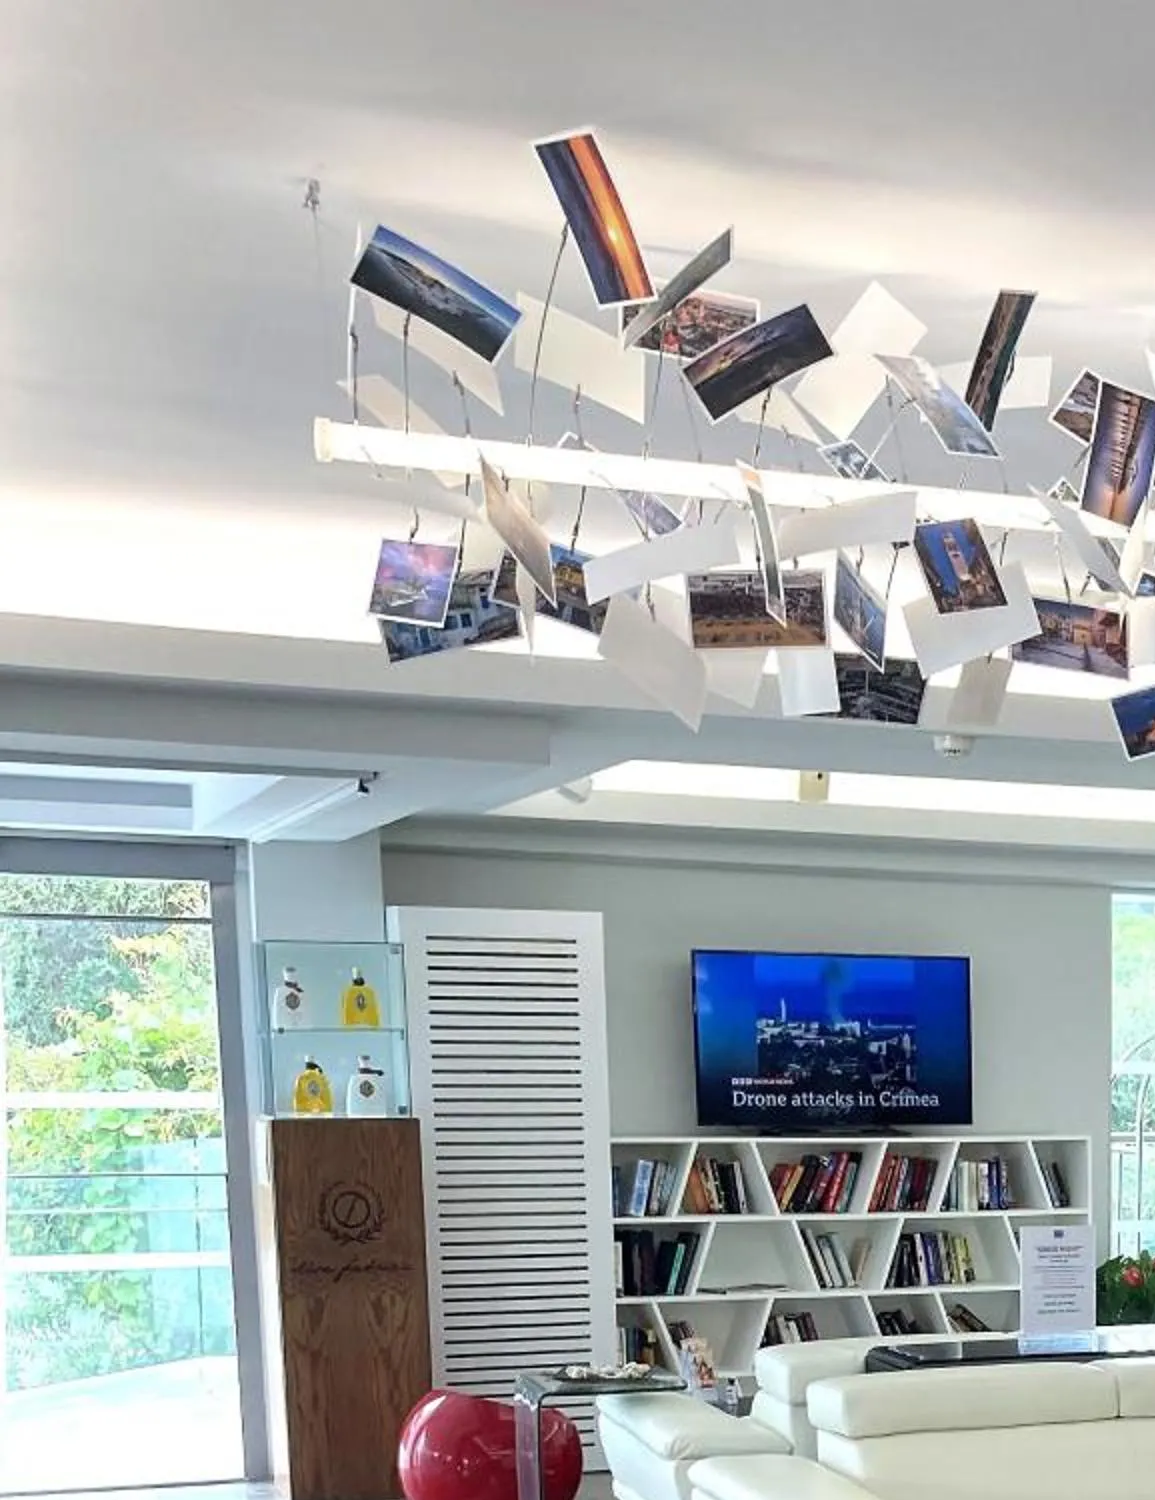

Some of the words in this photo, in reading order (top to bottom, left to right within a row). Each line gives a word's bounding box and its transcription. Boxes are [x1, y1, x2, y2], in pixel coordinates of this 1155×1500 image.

[733, 1090, 787, 1107] Drone
[791, 1089, 854, 1107] attacks
[859, 1090, 876, 1107] in
[880, 1091, 940, 1107] Crimea
